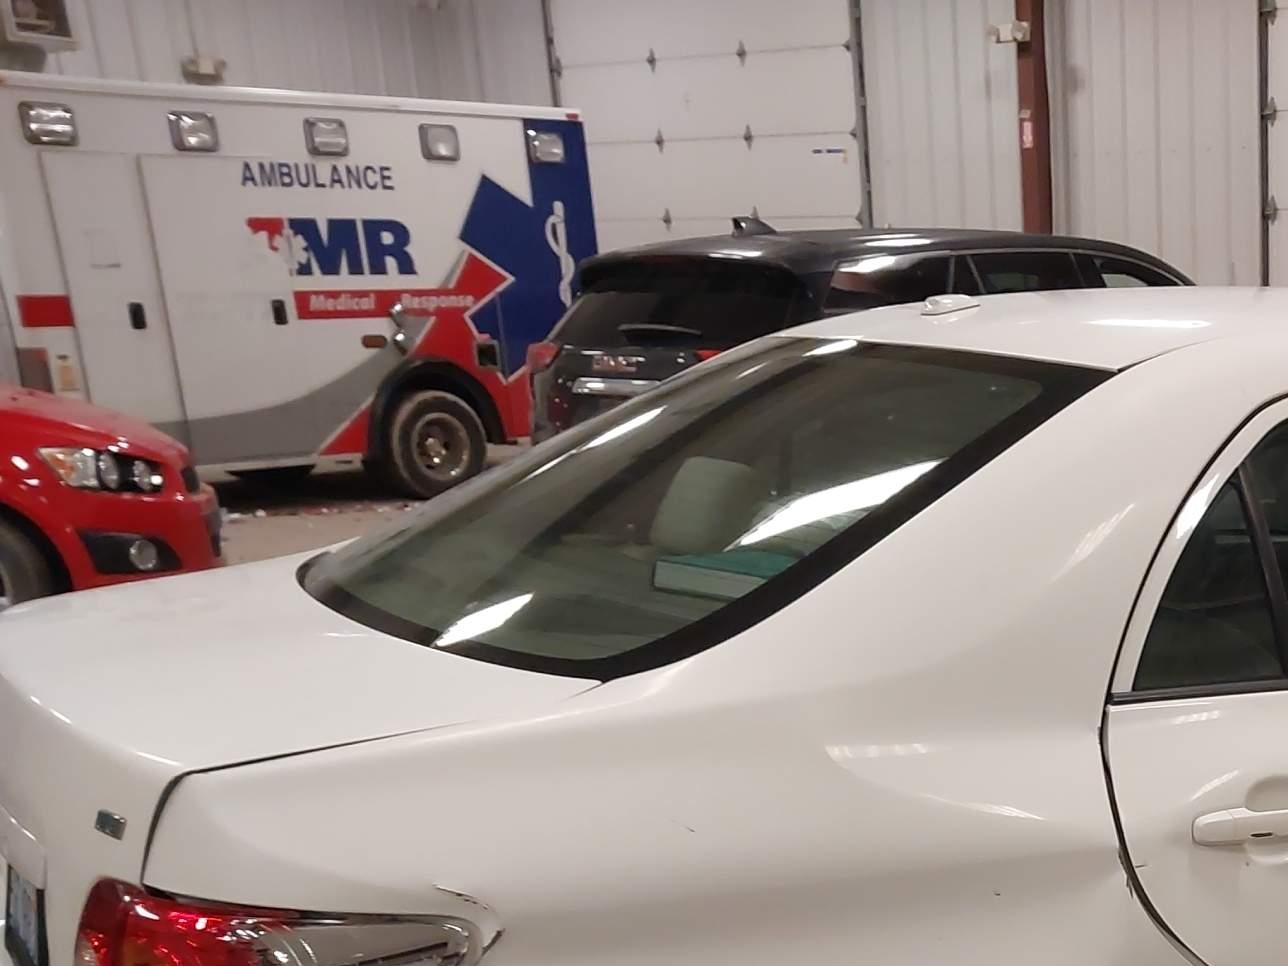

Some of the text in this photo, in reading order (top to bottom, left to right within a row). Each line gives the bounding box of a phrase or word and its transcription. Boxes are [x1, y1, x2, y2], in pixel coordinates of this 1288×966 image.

[241, 161, 395, 191] AMBULANCE
[309, 293, 474, 311] Medical Response
